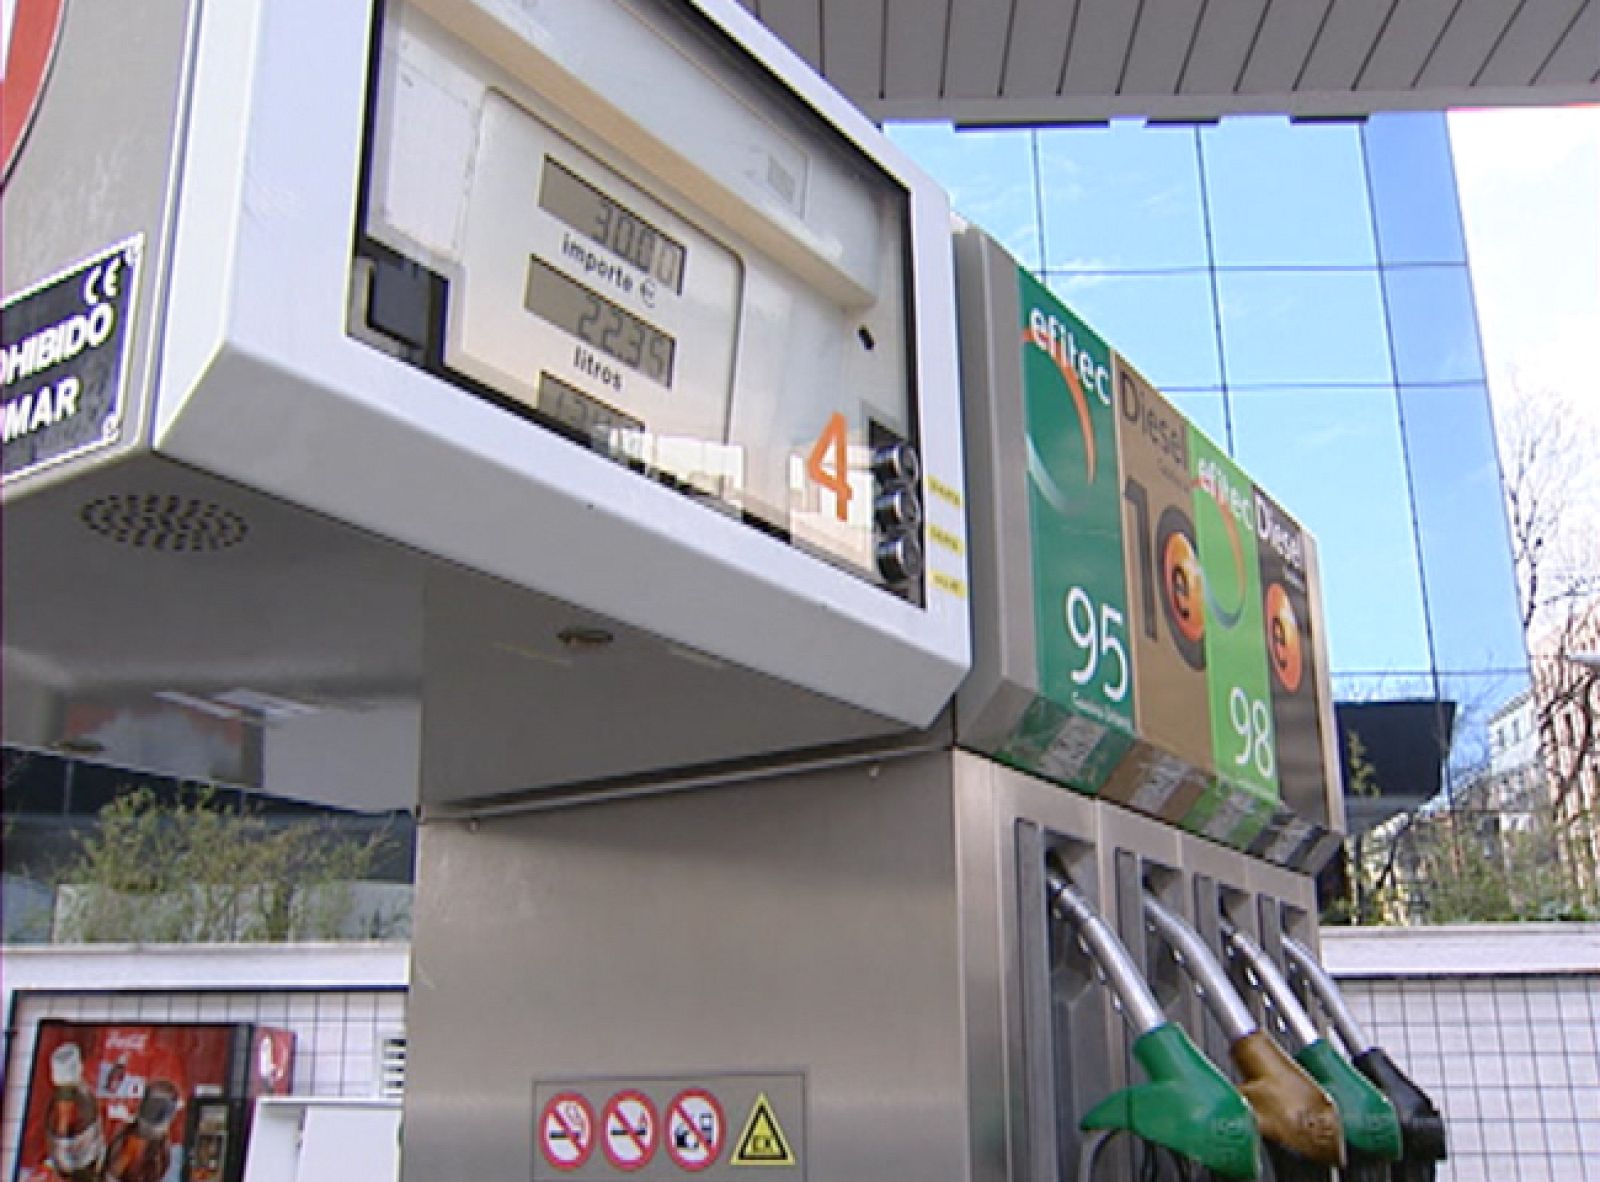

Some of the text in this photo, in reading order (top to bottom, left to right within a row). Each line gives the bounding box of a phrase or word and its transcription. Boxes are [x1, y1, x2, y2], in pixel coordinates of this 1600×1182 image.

[562, 231, 633, 292] importe
[0, 303, 115, 384] HIBIDO
[574, 345, 622, 392] litros
[1030, 307, 1111, 406] efitec
[807, 411, 854, 522] 4
[1121, 371, 1188, 470] Diesel
[1254, 492, 1304, 569] Diesel
[1066, 585, 1128, 702] 95
[1230, 686, 1274, 778] 98
